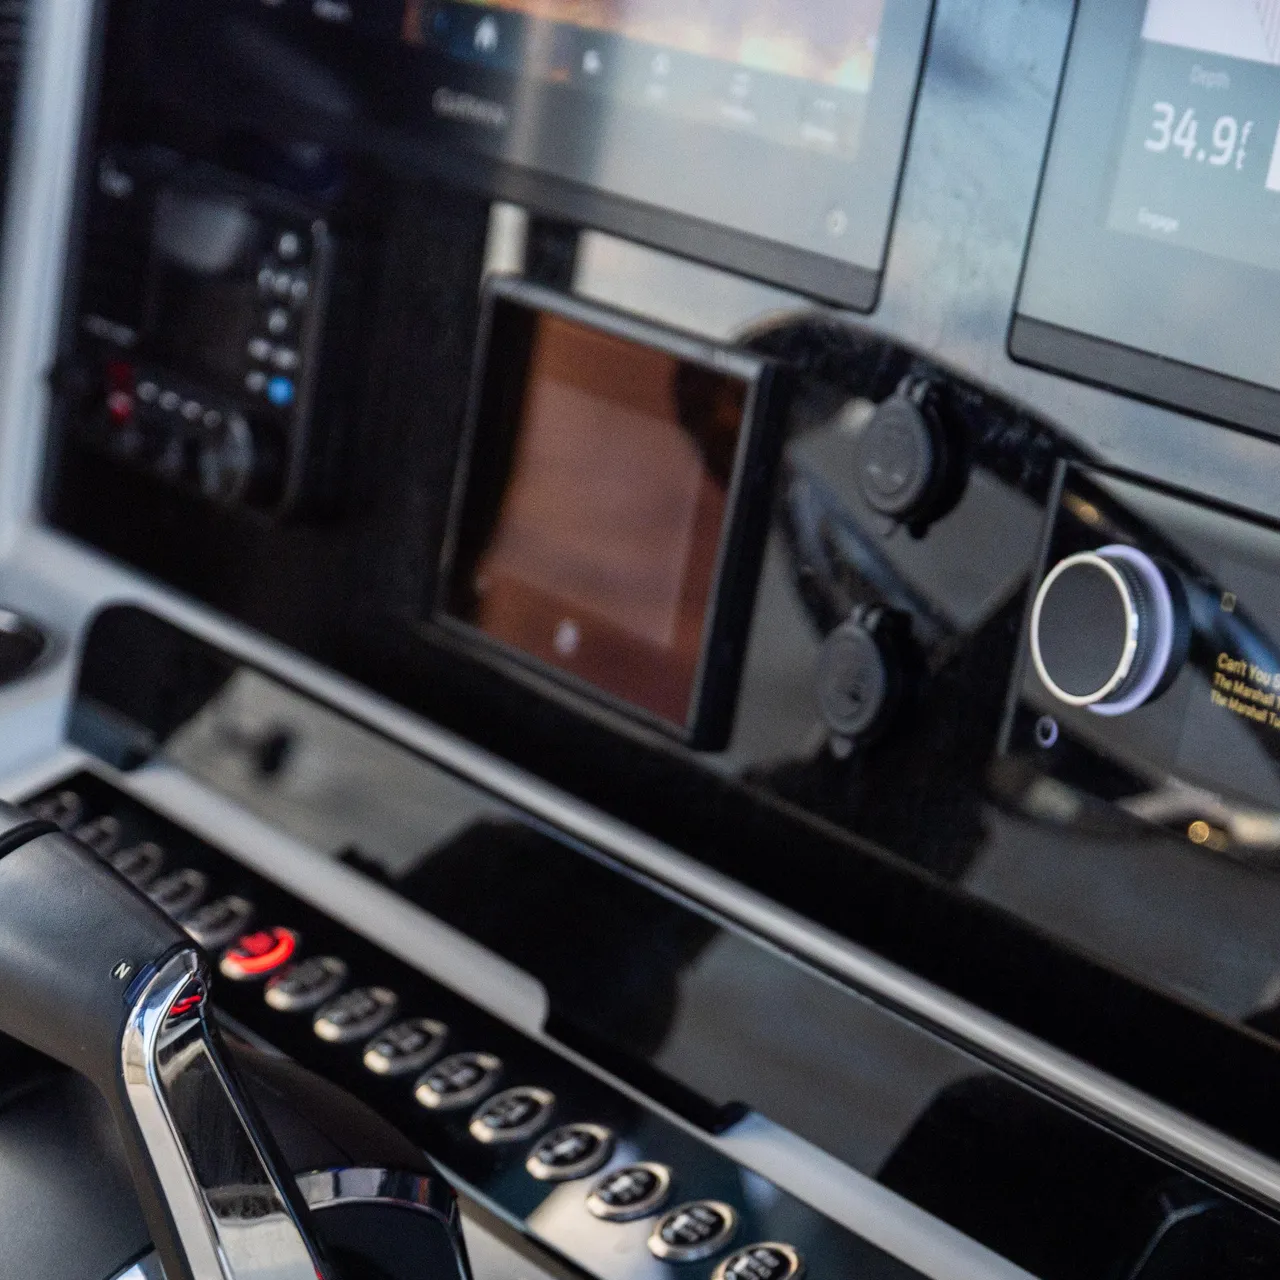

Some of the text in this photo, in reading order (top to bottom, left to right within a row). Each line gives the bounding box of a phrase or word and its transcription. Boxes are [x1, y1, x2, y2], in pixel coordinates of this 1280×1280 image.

[1144, 101, 1238, 166] 34.9
[1214, 671, 1234, 691] The
[1247, 663, 1272, 687] You
[114, 962, 131, 980] N
